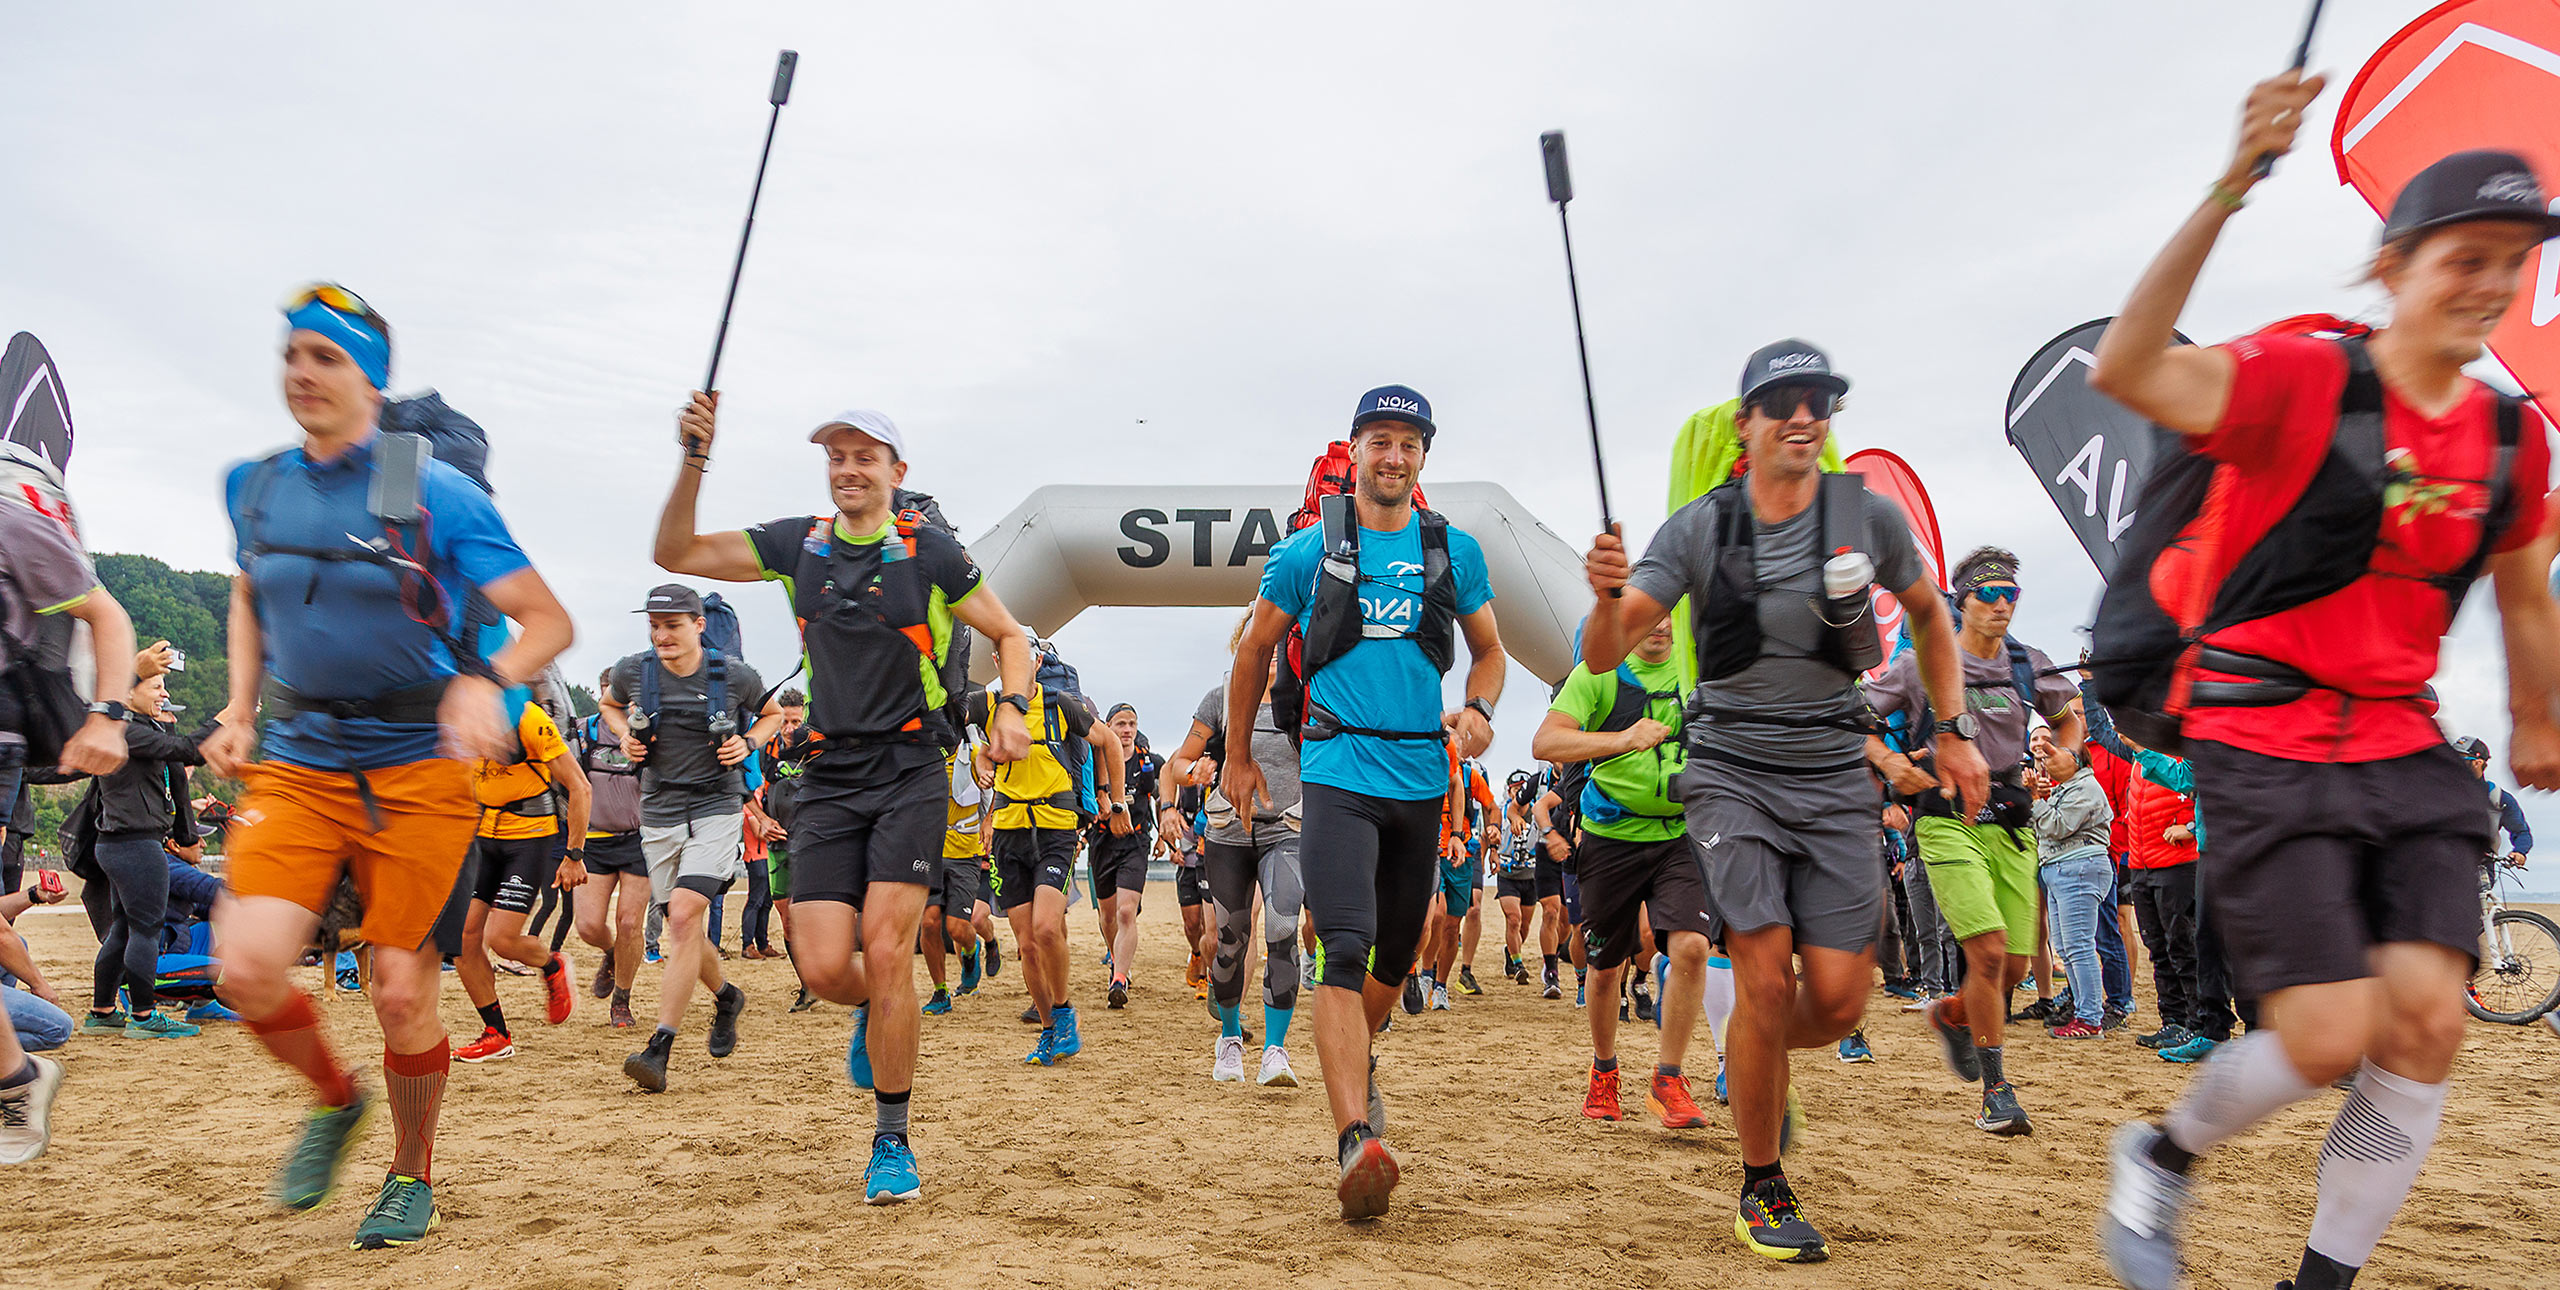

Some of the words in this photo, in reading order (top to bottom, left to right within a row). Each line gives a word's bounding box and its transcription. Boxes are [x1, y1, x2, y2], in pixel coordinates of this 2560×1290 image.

[1377, 396, 1419, 413] NOVA
[1116, 508, 1282, 568] STA
[1358, 597, 1412, 620] OVA
